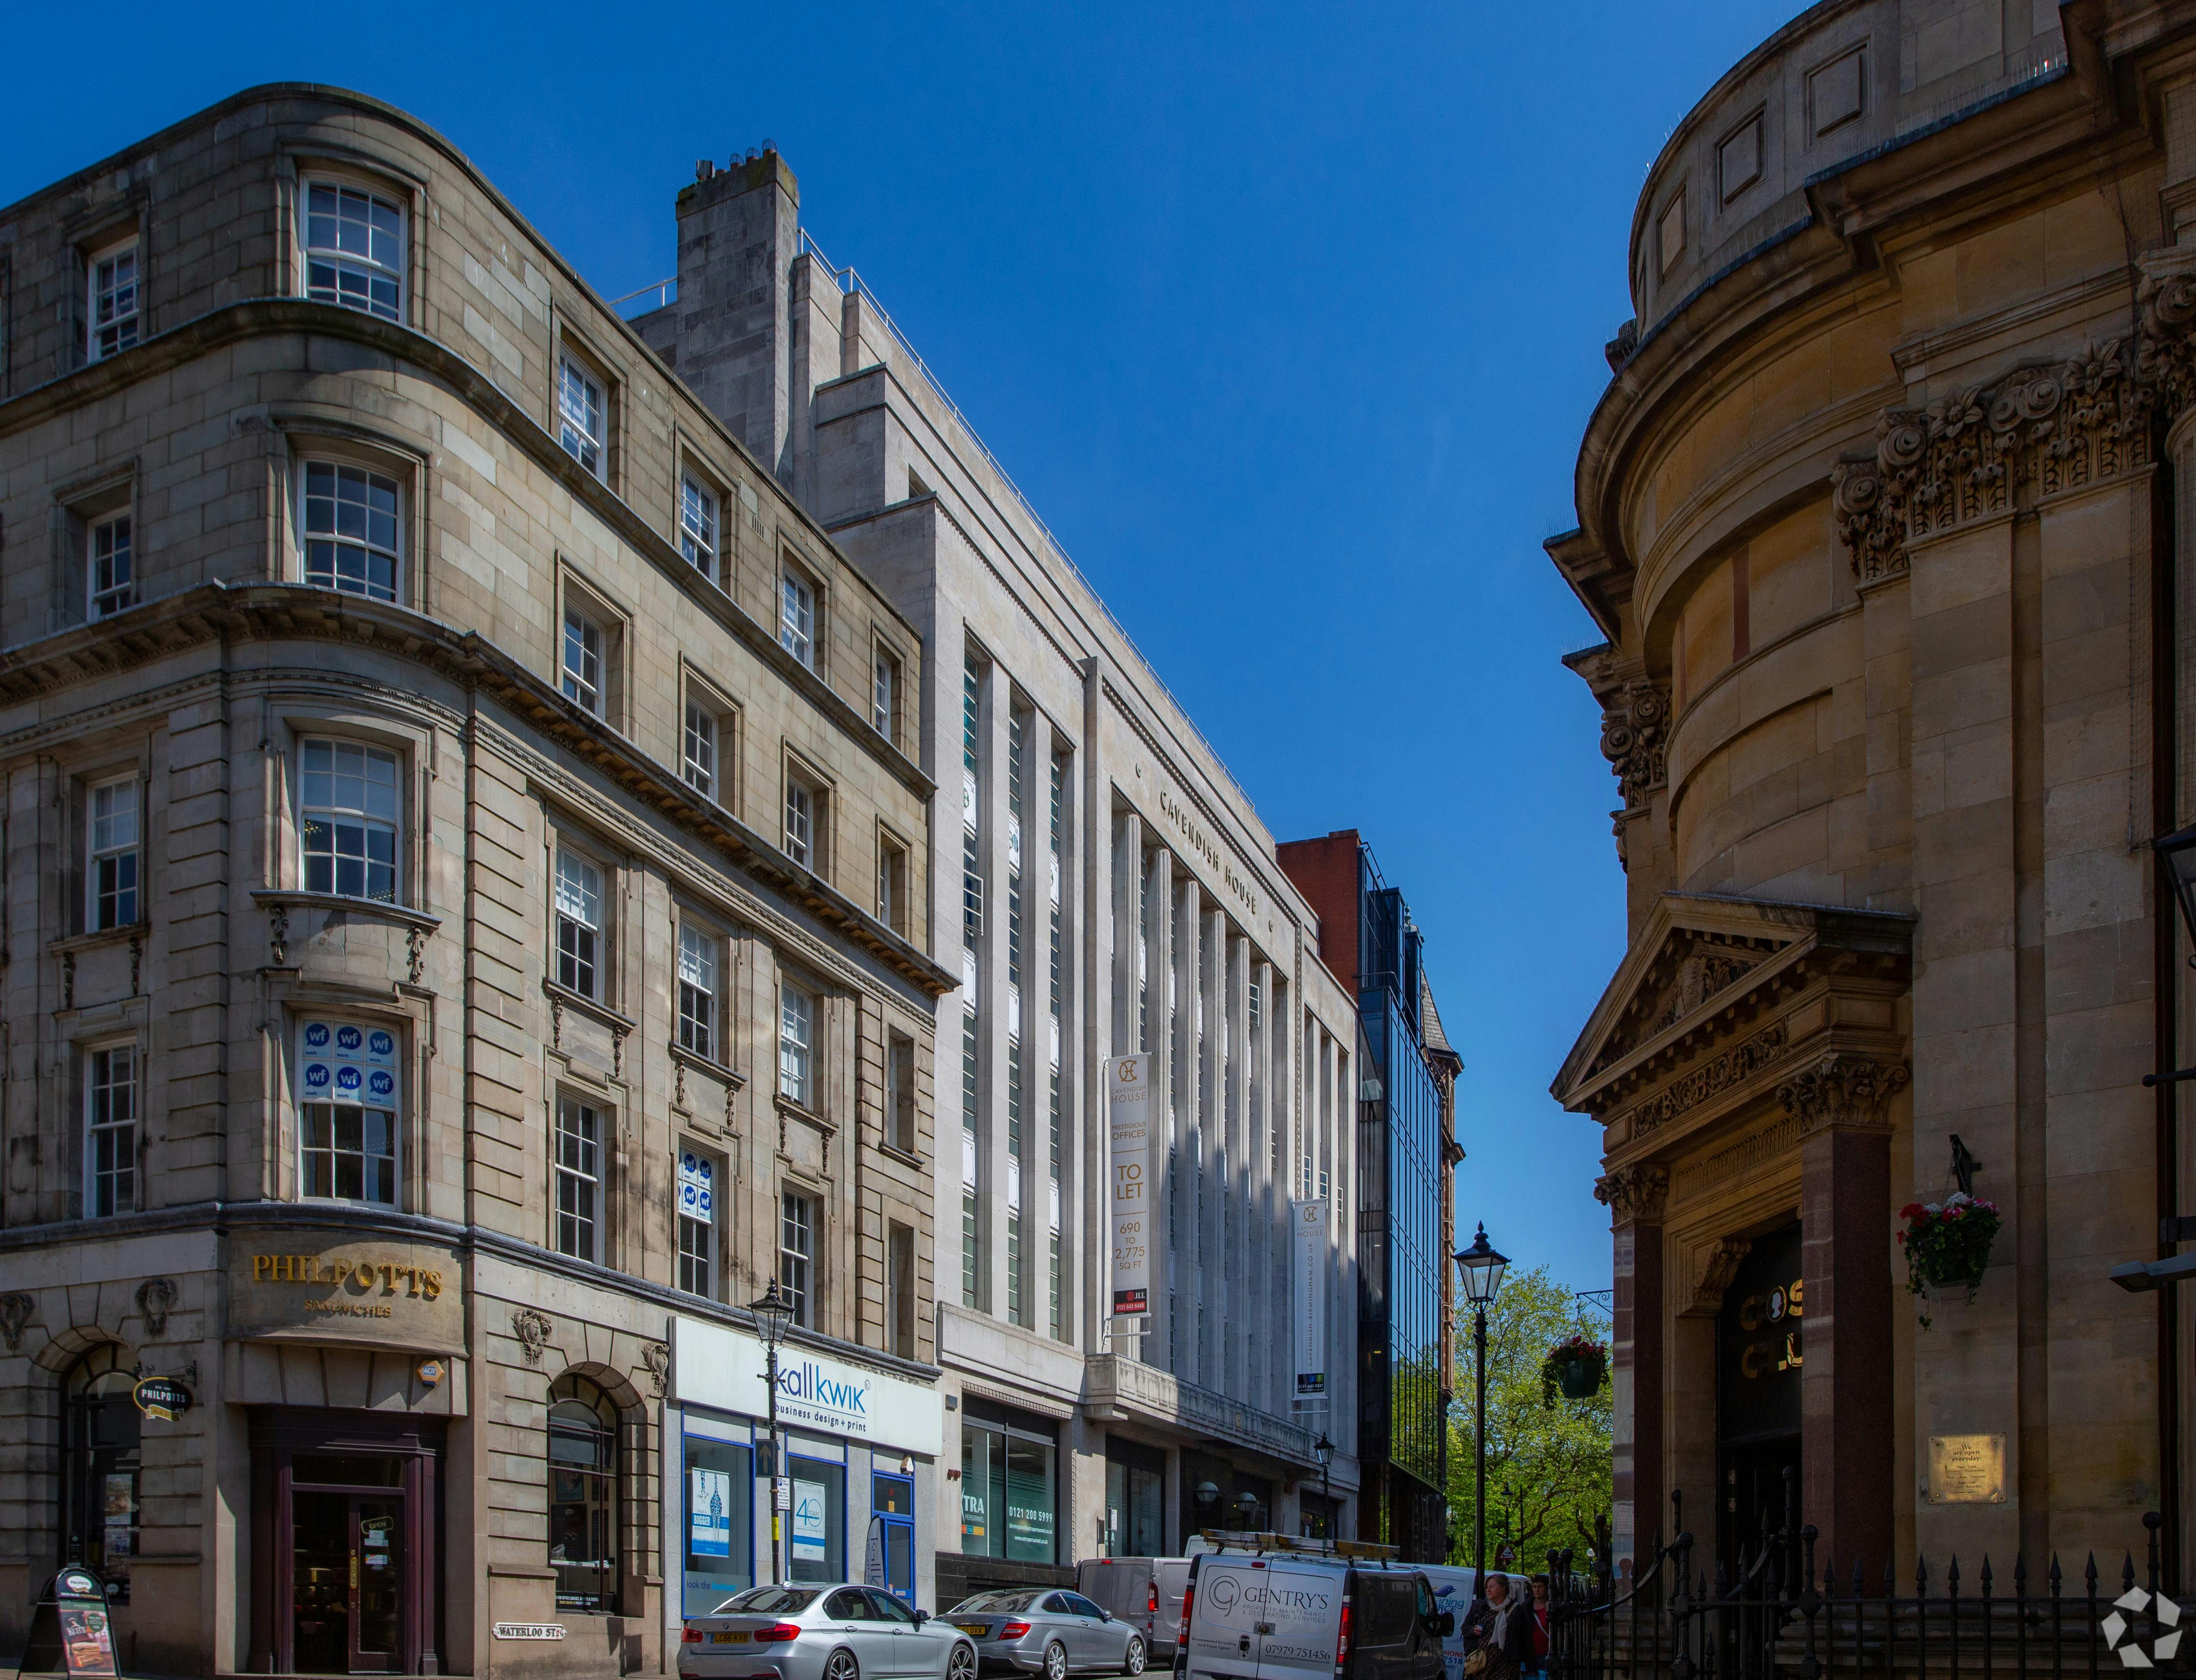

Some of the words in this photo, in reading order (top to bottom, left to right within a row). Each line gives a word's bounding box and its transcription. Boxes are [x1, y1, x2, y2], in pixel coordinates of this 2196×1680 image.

[1160, 790, 1218, 873] CAVENDISH
[1226, 865, 1256, 915] HOUSE
[309, 1029, 326, 1042] wf
[341, 1033, 358, 1045] wf
[372, 1038, 389, 1050] wf
[309, 1069, 326, 1082] wf
[340, 1073, 358, 1085] wf
[372, 1078, 389, 1090] wf
[1111, 1085, 1146, 1095] CAVENDISH
[1111, 1092, 1146, 1104] HOUSE
[1112, 1121, 1146, 1131] PRESTIGIOUS
[1112, 1129, 1146, 1140] OFFICES
[686, 1159, 695, 1169] wf
[701, 1166, 710, 1175] wf
[1117, 1164, 1141, 1181] TO
[686, 1191, 694, 1201] wf
[1116, 1182, 1144, 1200] LET
[701, 1197, 710, 1207] wf
[1120, 1222, 1141, 1234] 690
[1115, 1246, 1145, 1261] 2,775
[1119, 1262, 1131, 1270] SQ
[252, 1255, 443, 1297] PHILPOTTS
[304, 1299, 392, 1316] SANDWICHES
[1740, 1279, 1802, 1331] COS
[141, 1389, 185, 1402] PHILPOTTS
[775, 1402, 811, 1419] business
[815, 1412, 838, 1427] design
[848, 1420, 866, 1432] print
[694, 1515, 710, 1526] BIGGER
[965, 1514, 985, 1523] PERSONNEL
[1009, 1506, 1023, 1518] 0121
[1026, 1509, 1037, 1520] 200
[1039, 1511, 1053, 1523] 5999
[1009, 1523, 1053, 1534] birmingham@extrapersonnel.co.uk
[1015, 1535, 1048, 1545] www.extrapersonnel.co.uk
[686, 1579, 700, 1589] look
[701, 1581, 711, 1589] the
[712, 1581, 735, 1592] business
[1245, 1587, 1328, 1610] GENTRY'S
[1436, 1597, 1465, 1610] aning
[1248, 1611, 1290, 1619] DECORATING
[1293, 1615, 1326, 1623] SERVICES
[1279, 1608, 1327, 1618] MAINTENANCE
[499, 1627, 542, 1637] WATERLOO
[546, 1629, 556, 1637] ST
[1265, 1644, 1294, 1655] 07979
[1297, 1647, 1330, 1660] 751456
